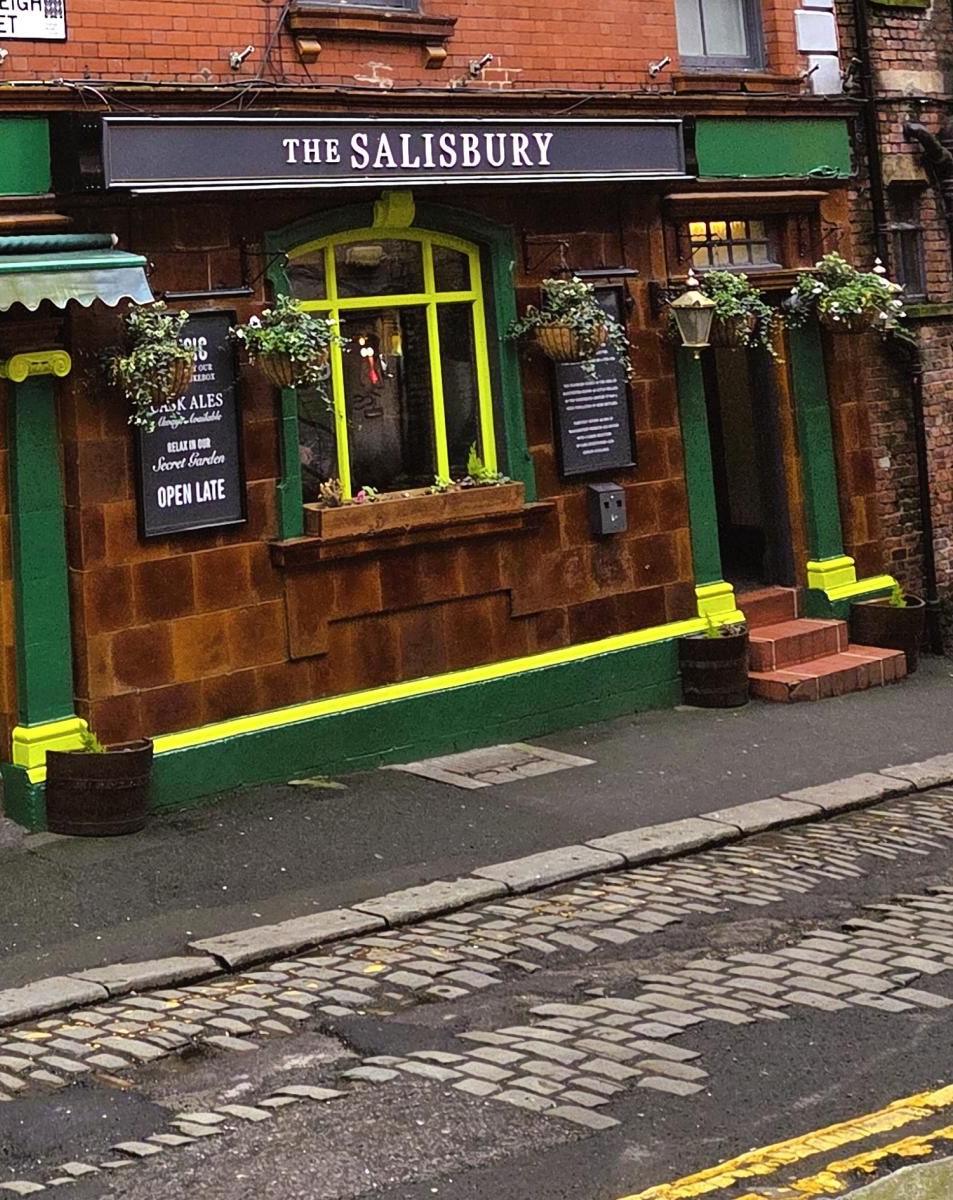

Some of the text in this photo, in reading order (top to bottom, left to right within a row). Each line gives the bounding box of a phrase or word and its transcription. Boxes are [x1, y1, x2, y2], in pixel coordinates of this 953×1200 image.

[282, 132, 554, 169] THE SALISBURY
[189, 393, 224, 410] ALES
[166, 440, 189, 453] RELAX
[152, 450, 225, 472] Secret Garden
[157, 478, 226, 508] OPEN LATE
